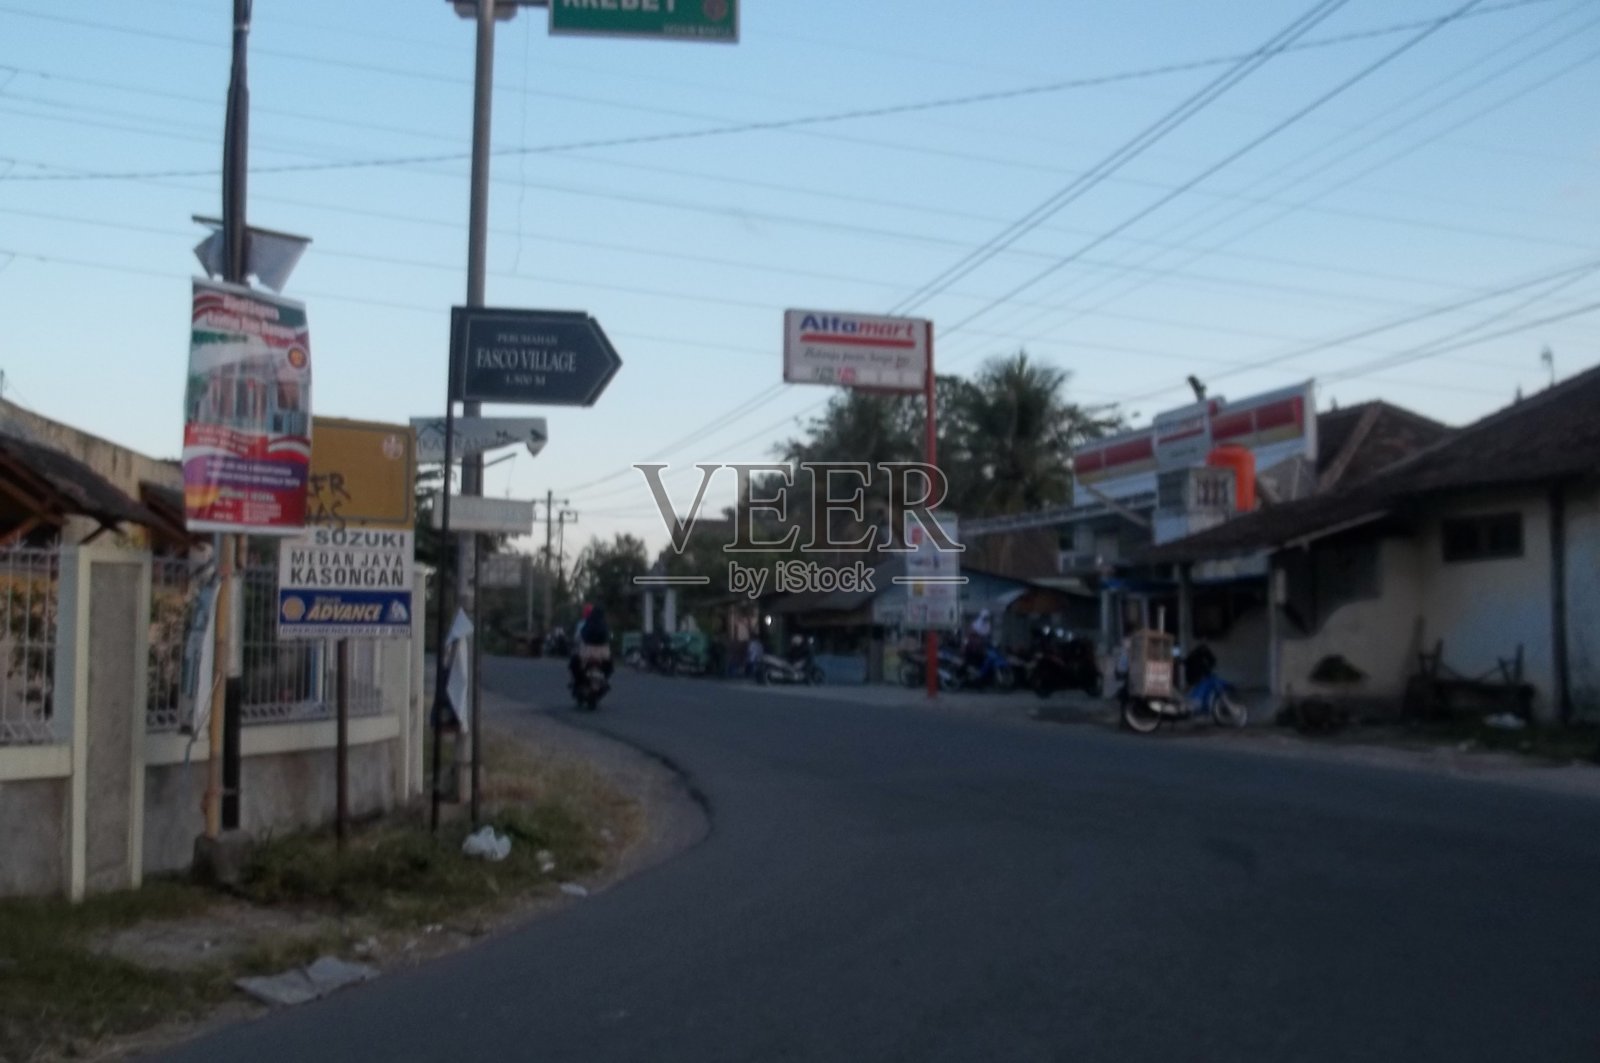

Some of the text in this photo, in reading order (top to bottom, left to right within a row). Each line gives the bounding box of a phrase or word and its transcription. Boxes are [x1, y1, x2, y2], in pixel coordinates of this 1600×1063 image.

[800, 314, 914, 337] Alfamart
[476, 347, 577, 373] FASCO VILLAGE
[315, 528, 405, 548] SOZUKI
[291, 550, 404, 568] MEDAN JAYA
[290, 567, 404, 587] KASONGAN
[306, 603, 383, 622] ADVANCE
